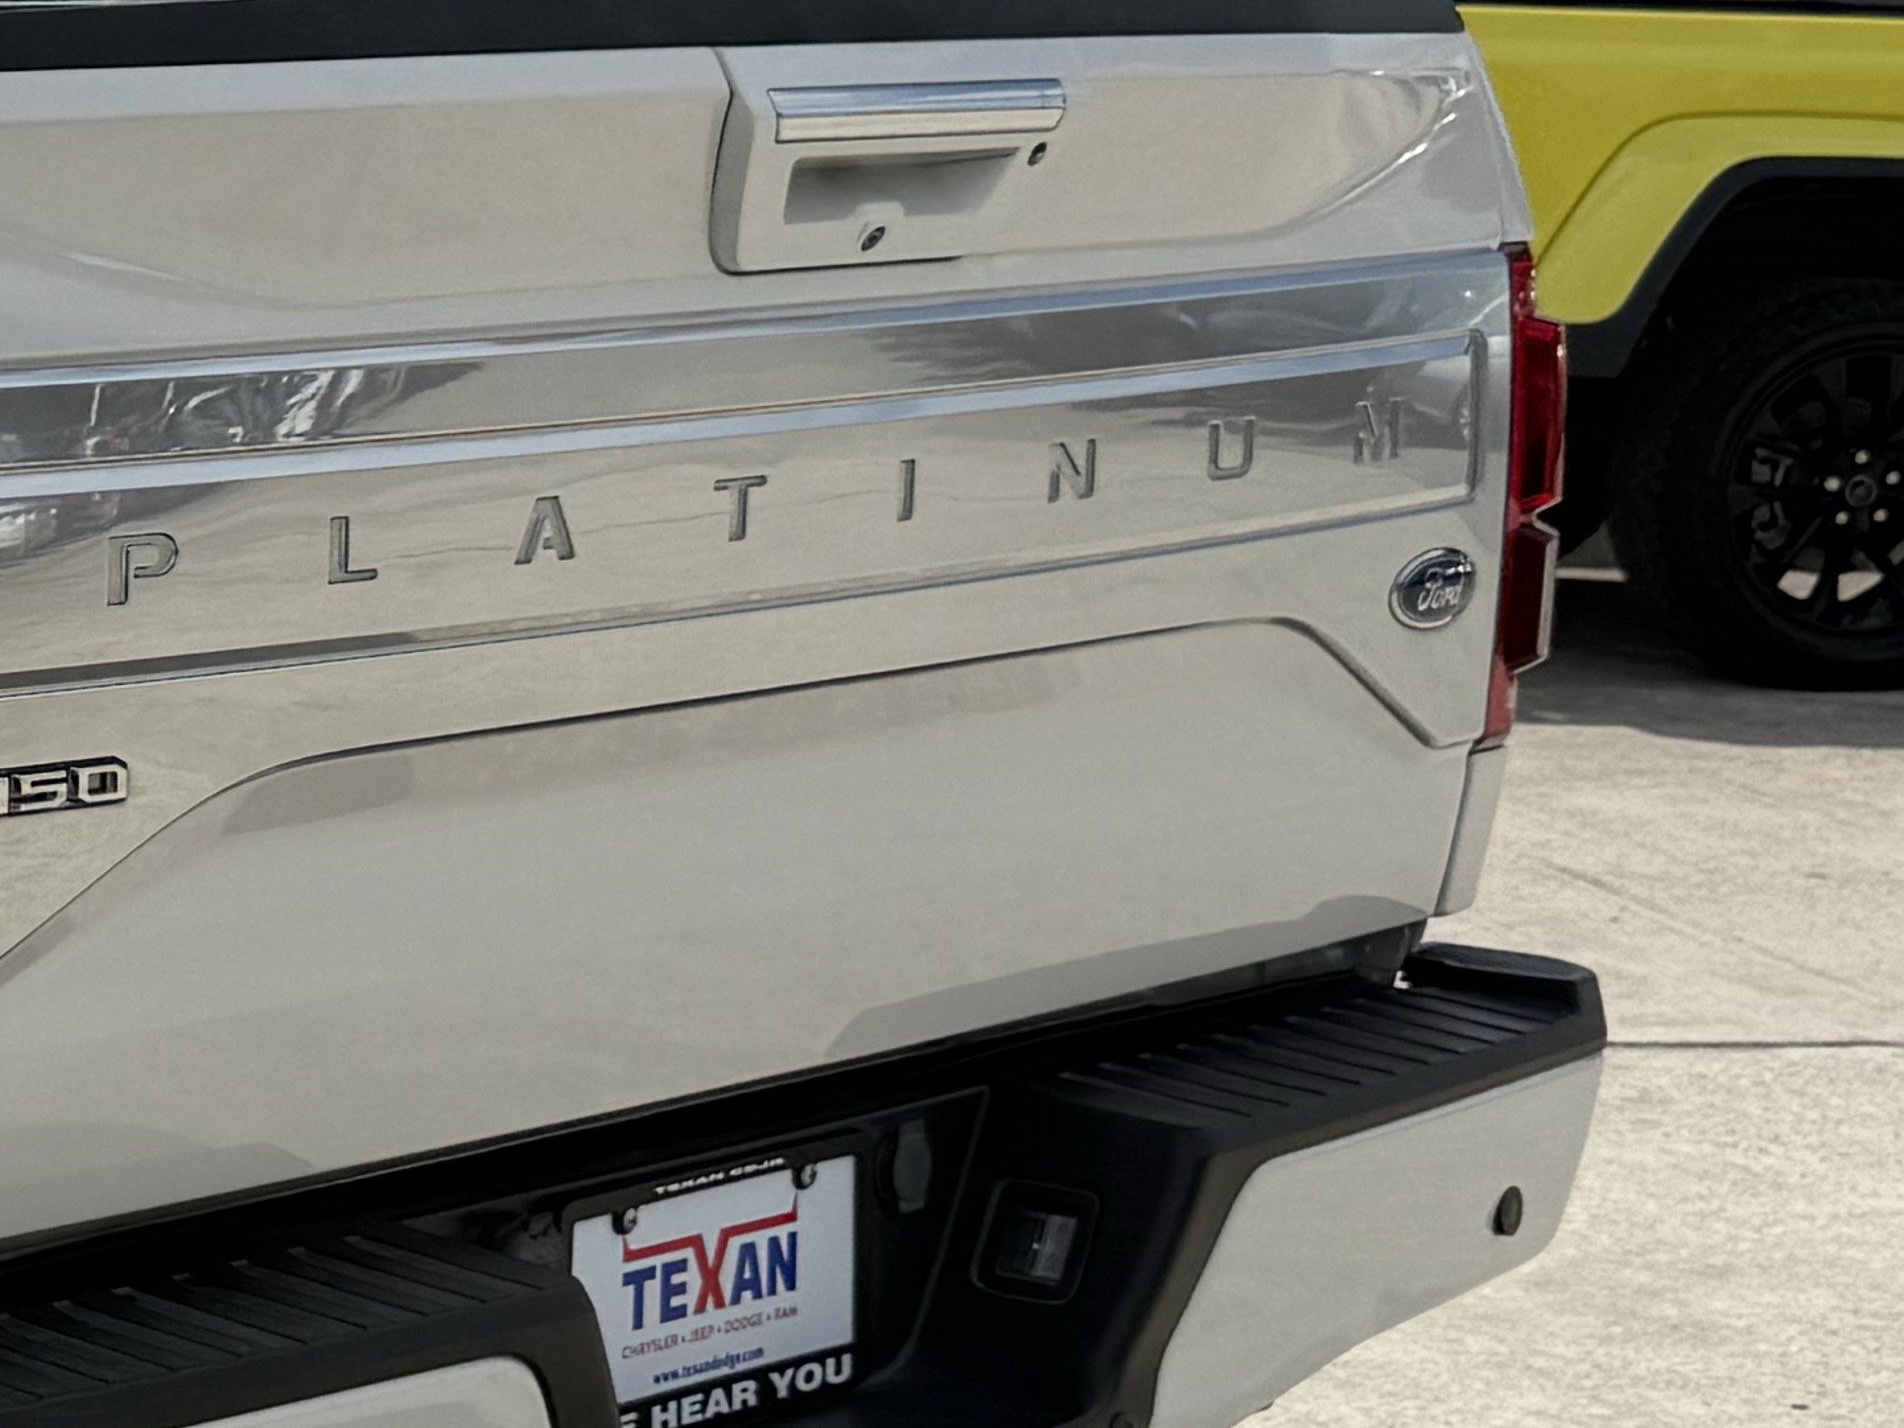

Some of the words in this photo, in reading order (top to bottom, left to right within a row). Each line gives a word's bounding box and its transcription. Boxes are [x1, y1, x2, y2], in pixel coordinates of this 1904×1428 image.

[106, 397, 1408, 608] PLATINUM
[621, 1222, 798, 1332] TEXAN
[621, 1333, 680, 1360] CHRYSLER
[685, 1323, 715, 1344] JEEP
[724, 1311, 765, 1334] DODGE
[773, 1305, 799, 1321] RAM
[767, 1352, 854, 1399] YOU
